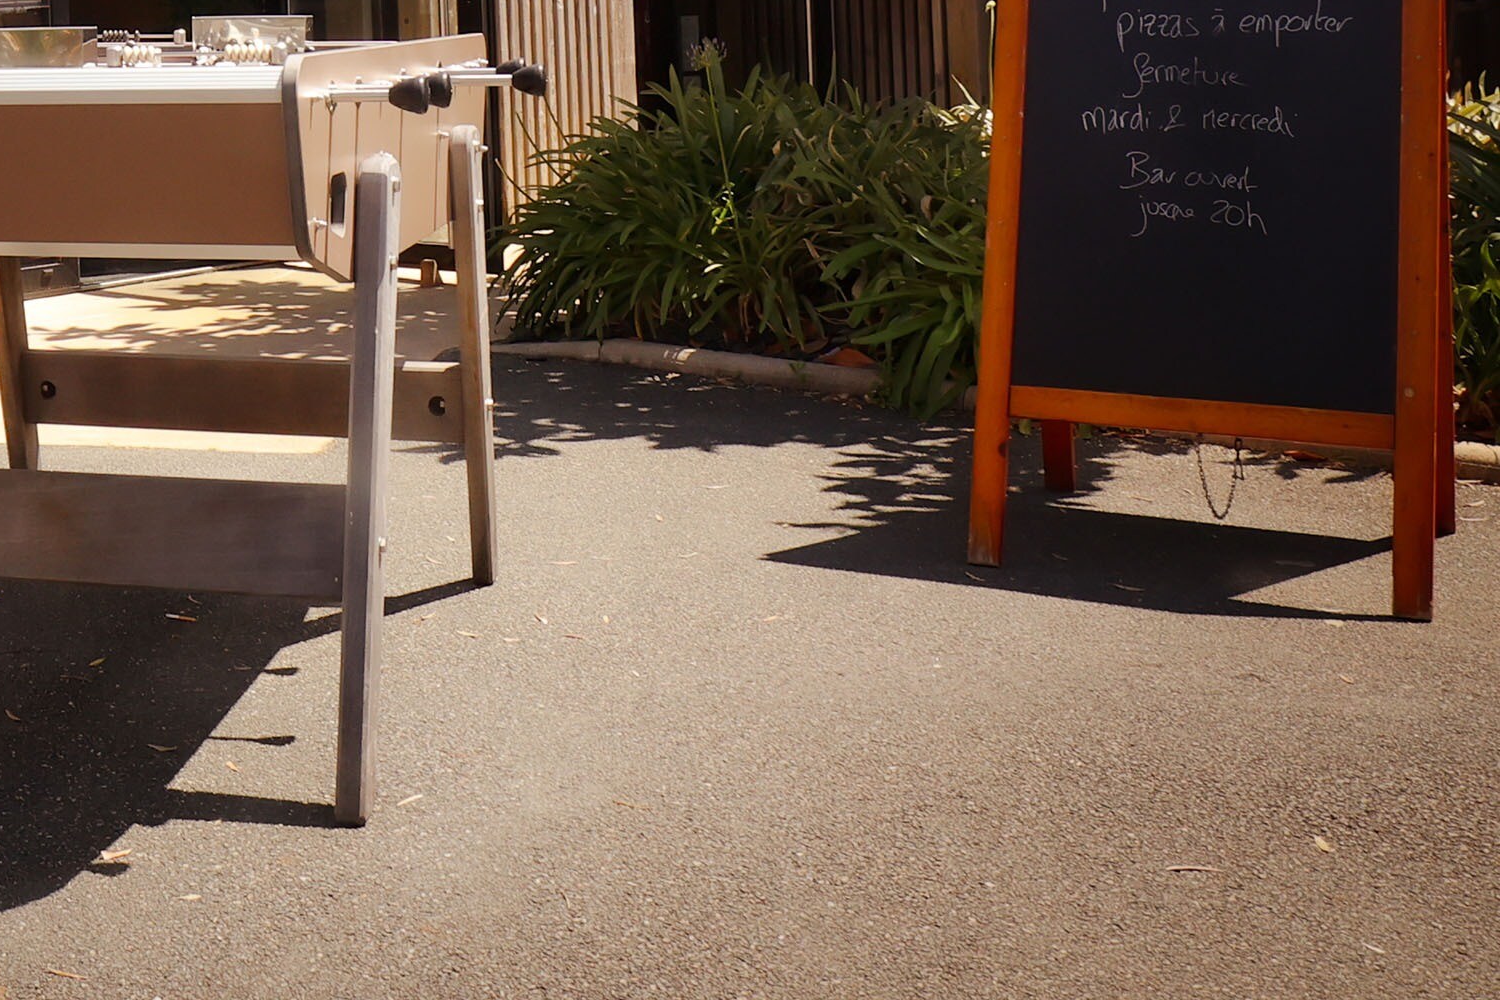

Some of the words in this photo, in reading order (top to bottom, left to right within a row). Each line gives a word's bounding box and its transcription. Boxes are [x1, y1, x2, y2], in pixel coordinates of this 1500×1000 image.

[1116, 8, 1201, 53] pizzas
[1118, 150, 1177, 189] Bar
[1210, 199, 1268, 236] 20h
